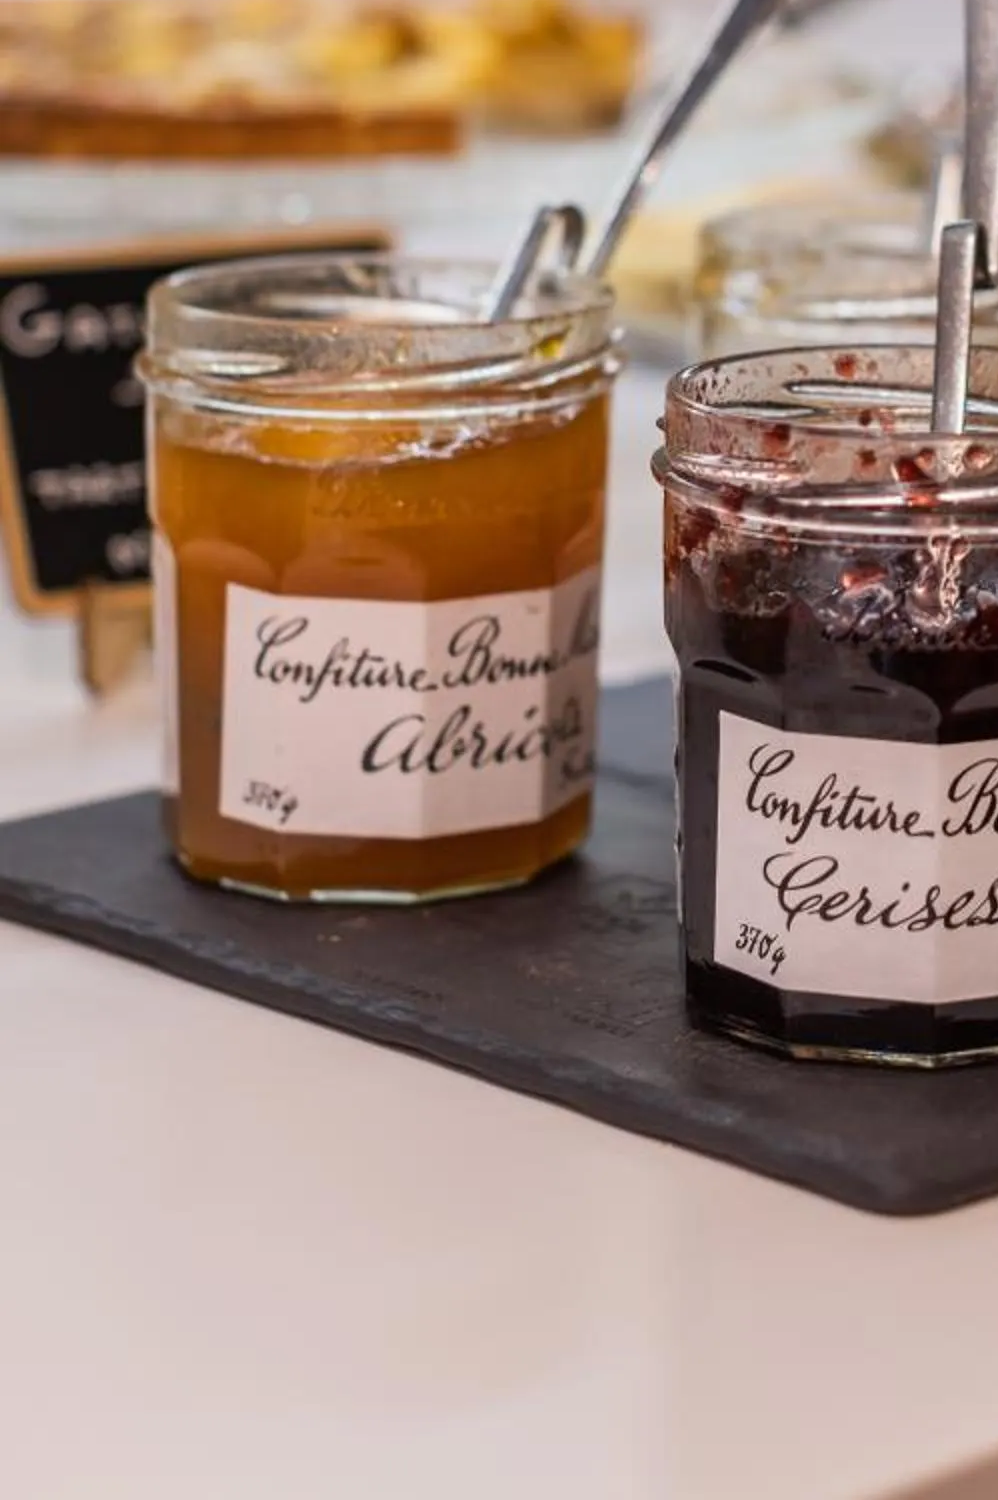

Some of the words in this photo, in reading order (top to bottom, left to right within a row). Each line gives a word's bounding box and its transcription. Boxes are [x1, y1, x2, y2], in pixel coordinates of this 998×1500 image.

[255, 615, 437, 703] Confiture
[746, 743, 934, 844] Confiture
[734, 923, 786, 976] 370g
